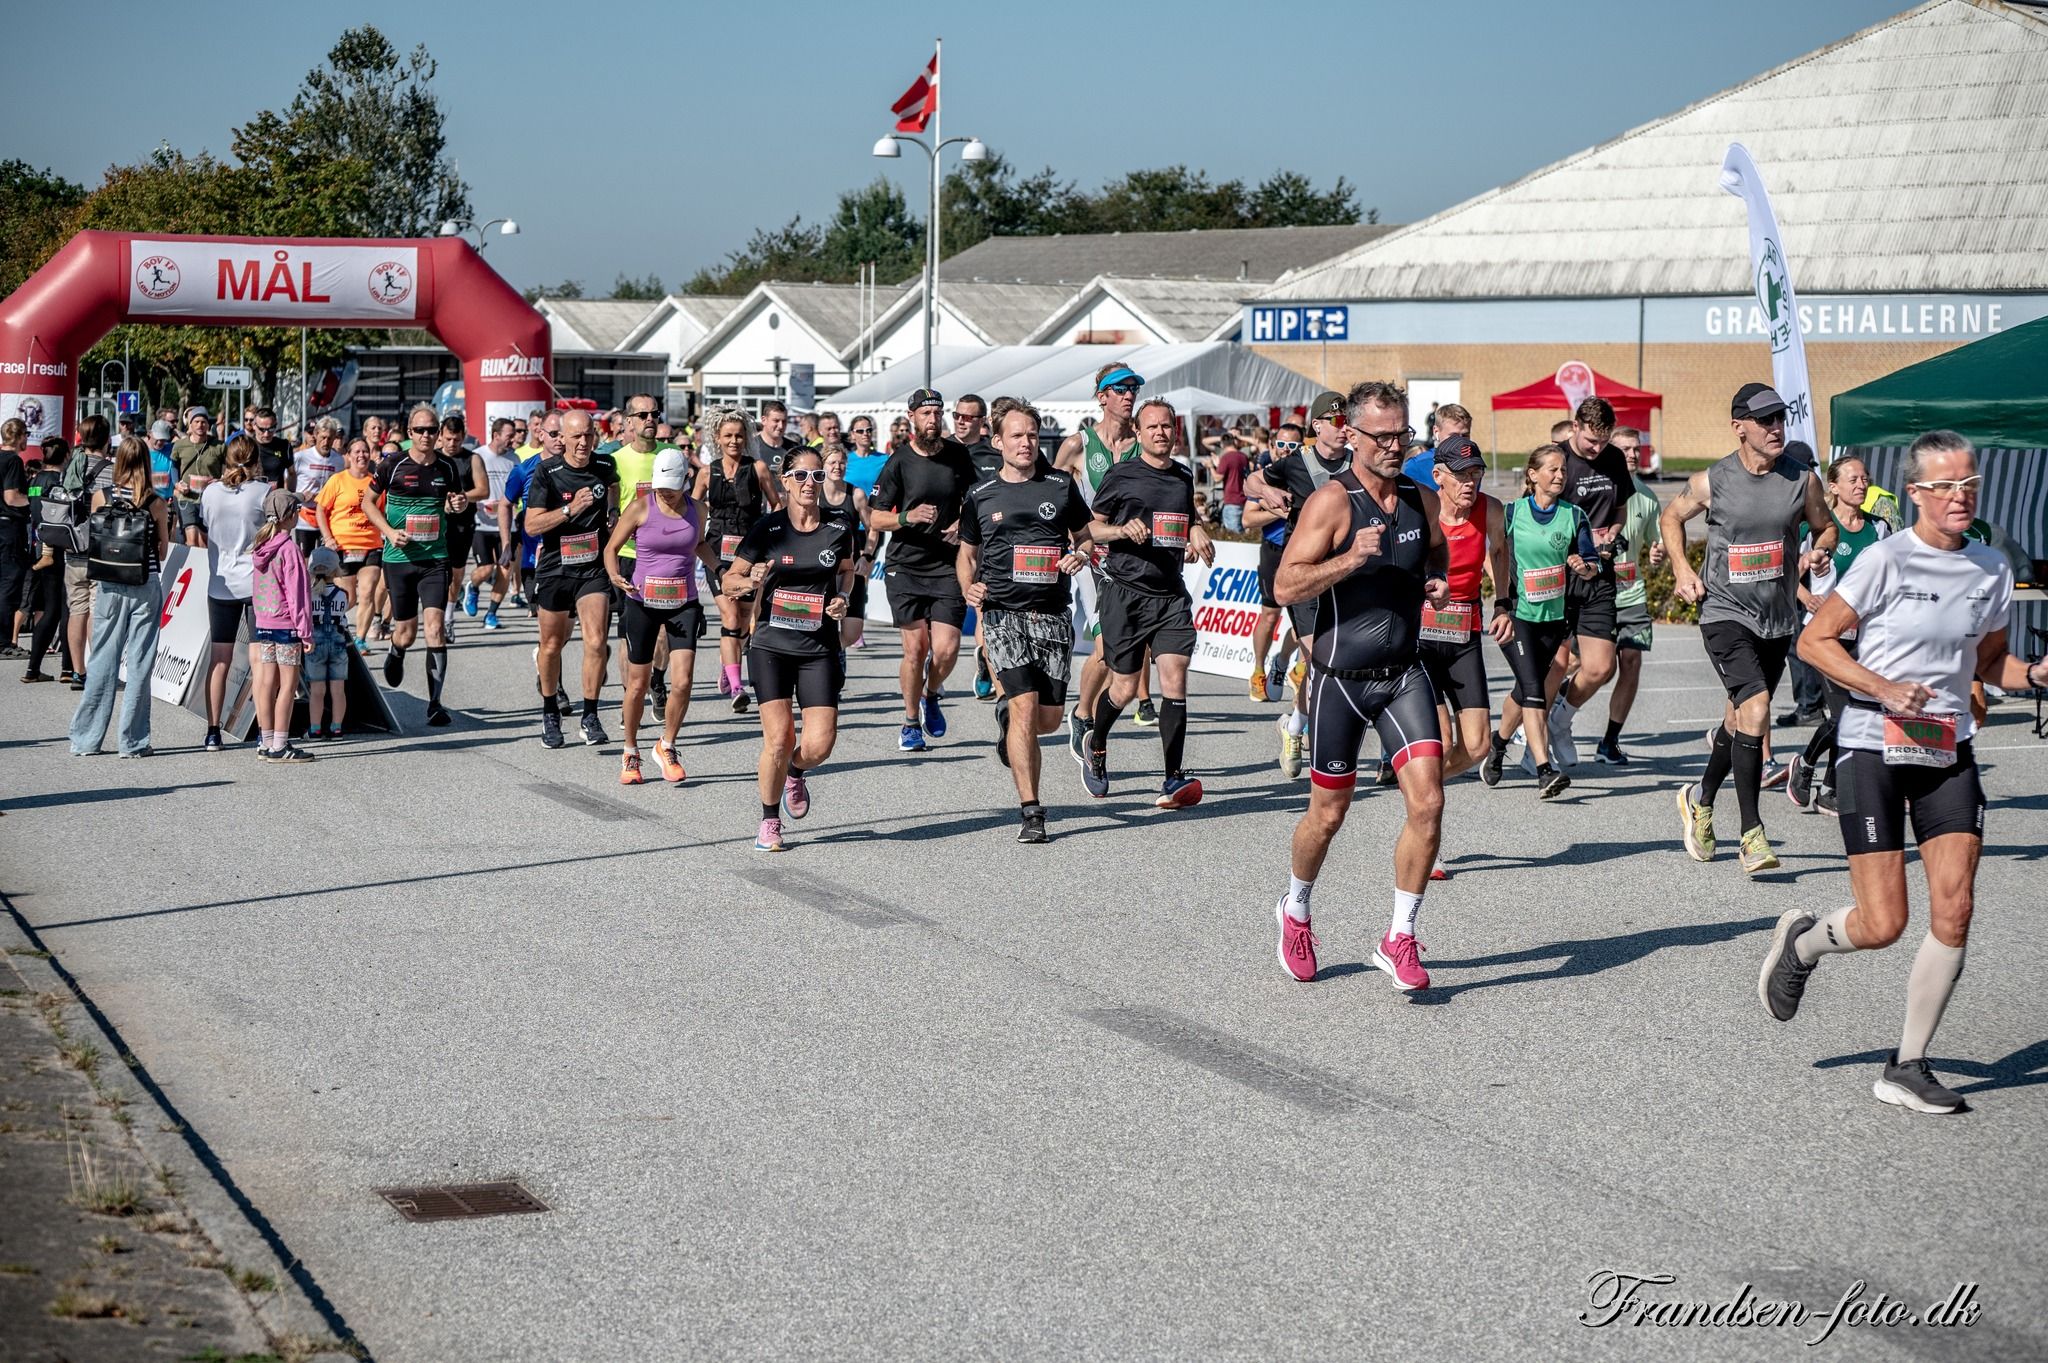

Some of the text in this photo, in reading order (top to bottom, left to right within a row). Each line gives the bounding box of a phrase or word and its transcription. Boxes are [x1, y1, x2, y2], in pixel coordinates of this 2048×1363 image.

[217, 250, 331, 303] MÅL
[1014, 548, 1060, 556] GRÆNSELØBET
[1728, 543, 1783, 554] GRÆNSELØBET
[1731, 569, 1767, 577] FRØSLEV
[774, 591, 823, 603] GRÆNSELØBET
[772, 615, 805, 624] FRØSLEV
[1422, 627, 1457, 636] FRØSLEV
[1888, 747, 1937, 756] FRØSLEV
[1865, 816, 1878, 843] FUSION
